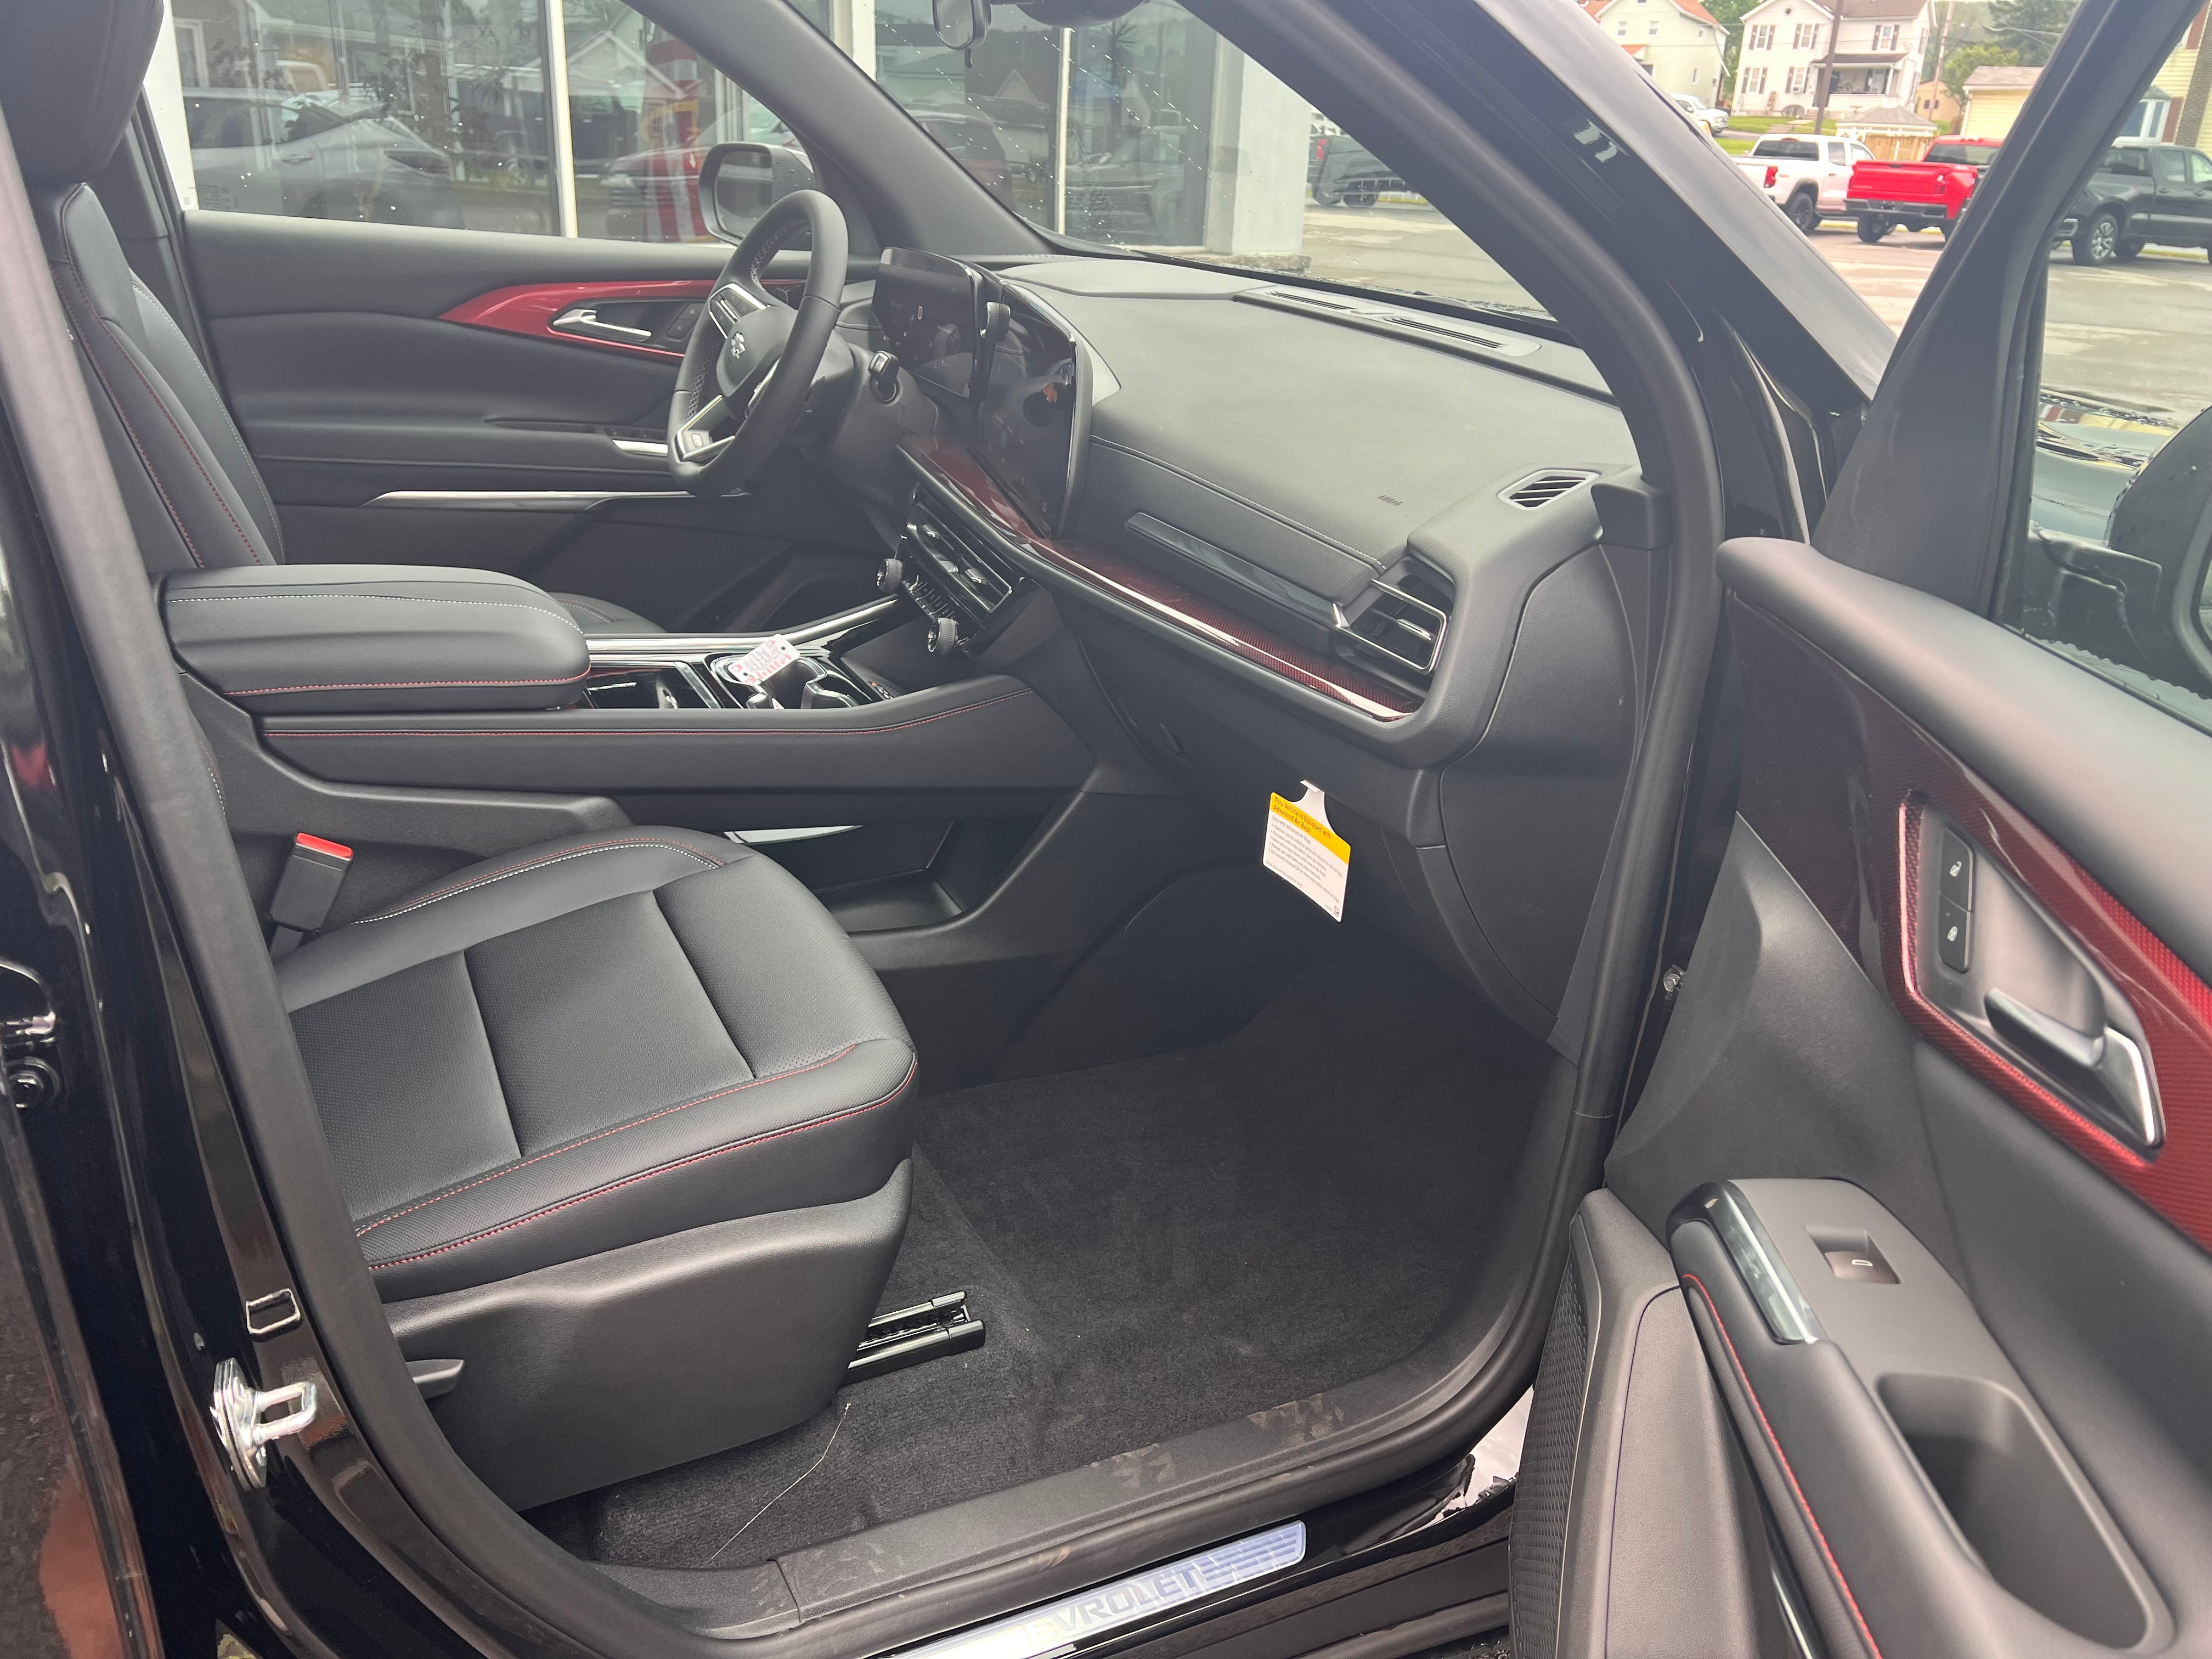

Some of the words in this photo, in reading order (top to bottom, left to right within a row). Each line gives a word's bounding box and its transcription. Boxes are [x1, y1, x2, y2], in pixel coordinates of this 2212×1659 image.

[1376, 495, 1403, 506] AIRBAG
[1273, 804, 1294, 821] Advanced
[1275, 797, 1284, 807] This
[1284, 803, 1299, 816] Vehicle
[979, 1565, 1197, 1652] EVROLET
